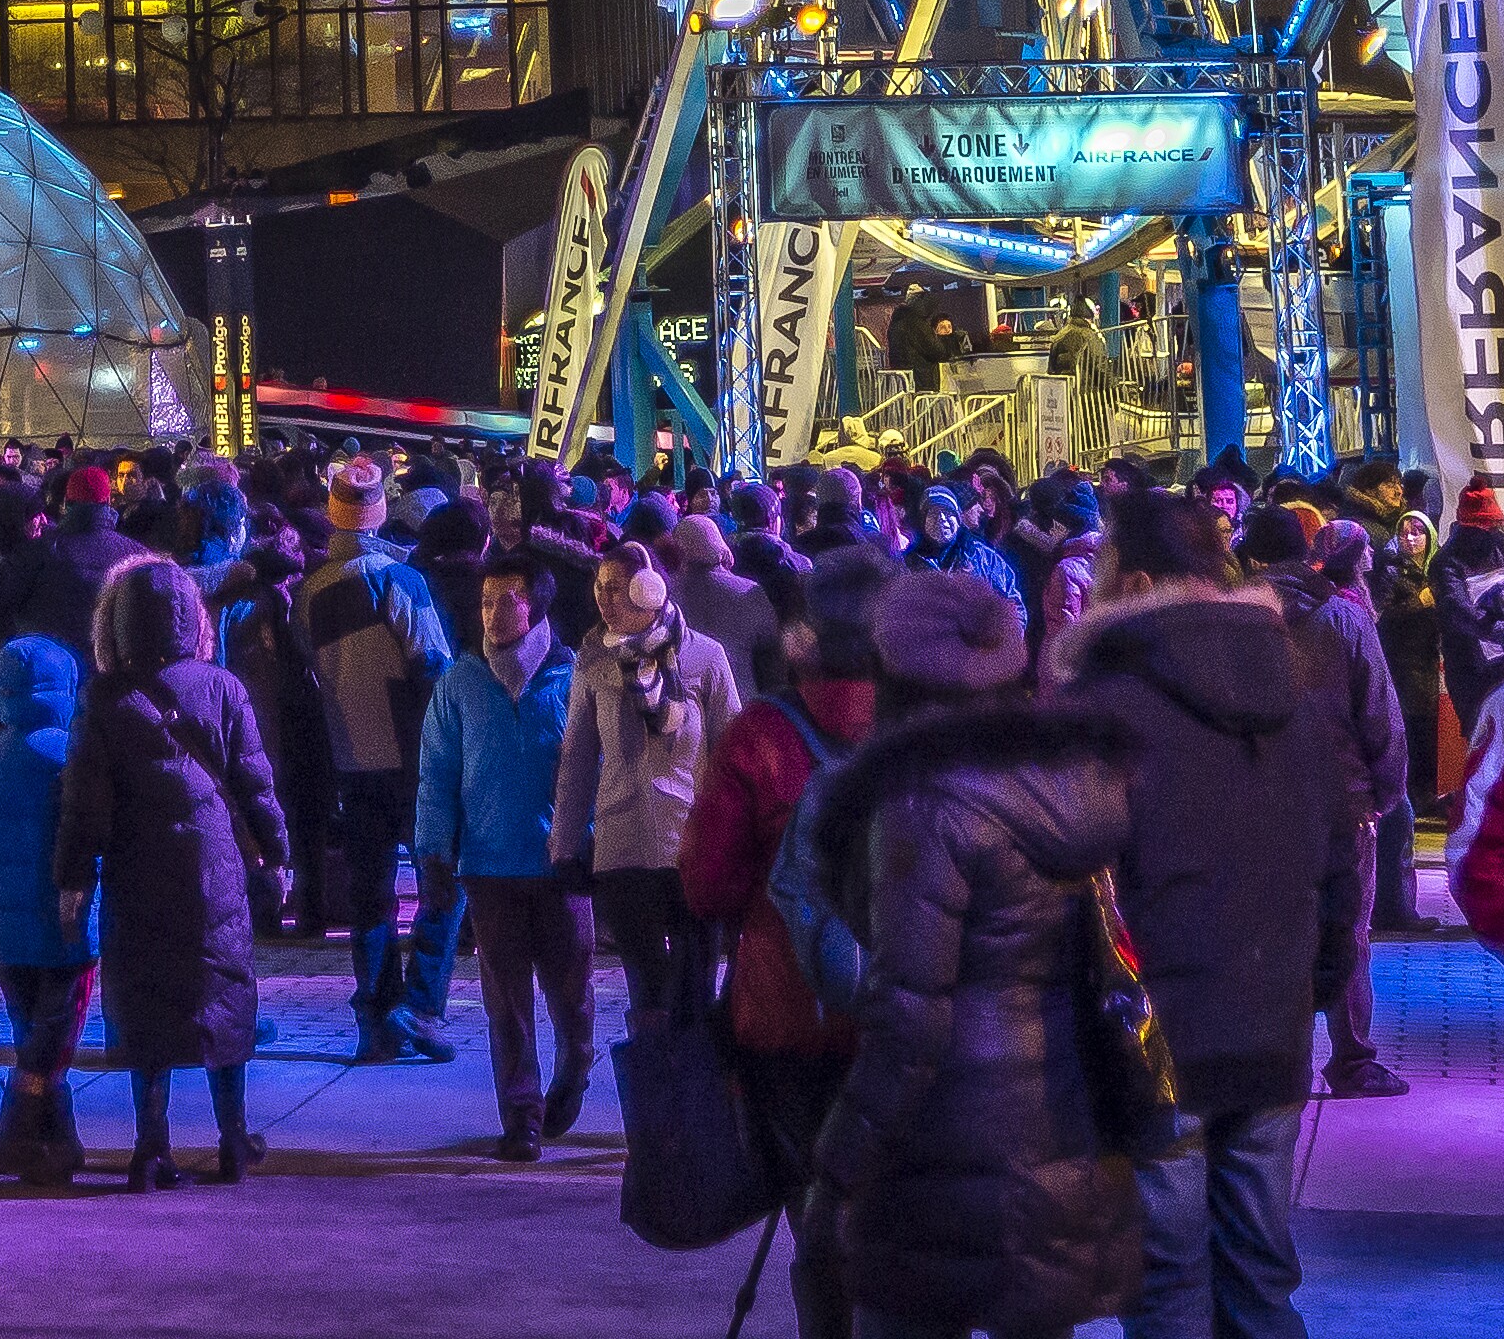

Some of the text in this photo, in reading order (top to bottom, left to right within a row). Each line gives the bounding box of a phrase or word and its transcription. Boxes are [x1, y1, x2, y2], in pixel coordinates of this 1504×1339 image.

[809, 147, 868, 165] MONTRÉAL
[941, 134, 1007, 159] ZONE
[1073, 148, 1195, 164] AIRFRANCE
[892, 164, 1057, 186] D'EMBARQUEMENT
[213, 316, 230, 456] SPHÈRE Provigo
[239, 314, 253, 446] PHÈRE Provigo
